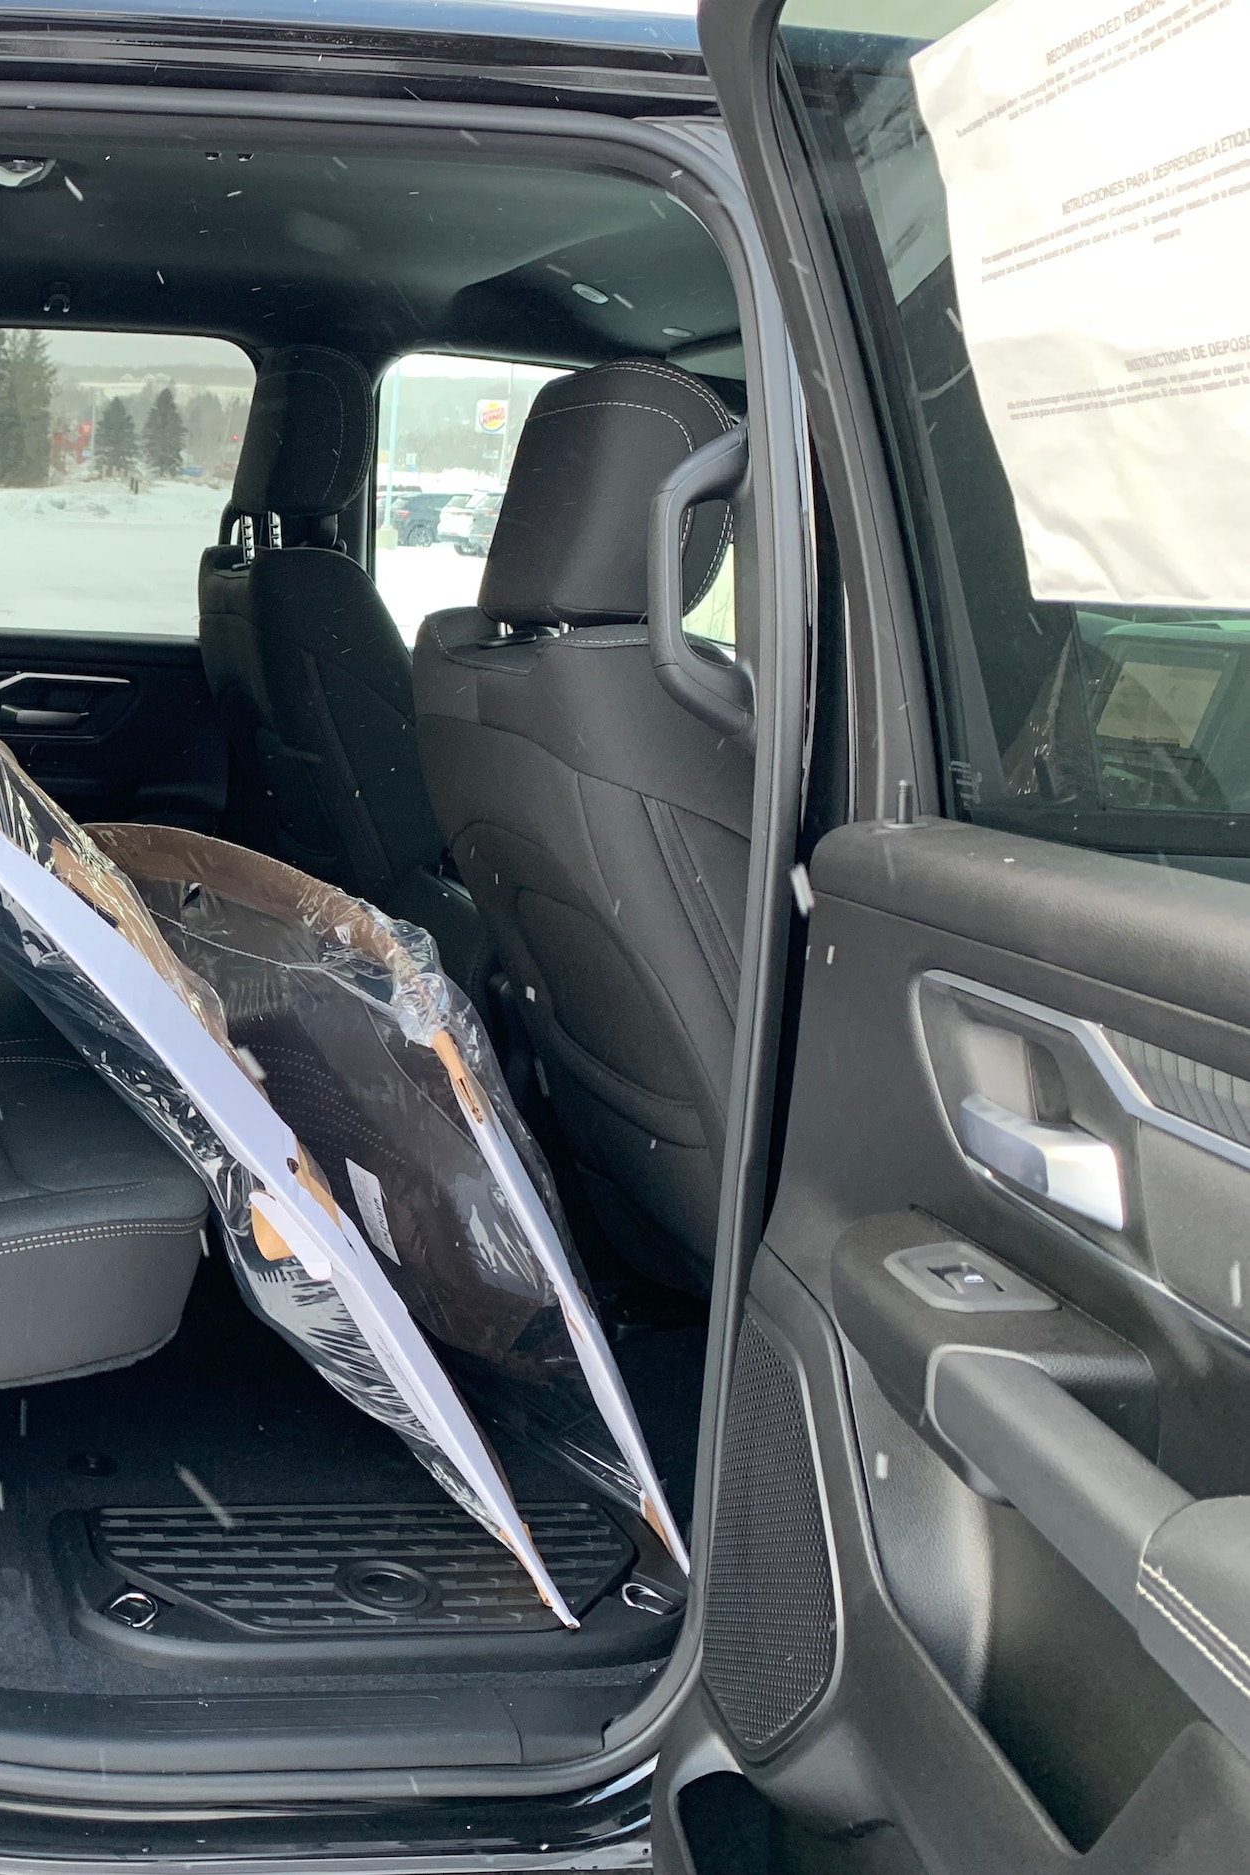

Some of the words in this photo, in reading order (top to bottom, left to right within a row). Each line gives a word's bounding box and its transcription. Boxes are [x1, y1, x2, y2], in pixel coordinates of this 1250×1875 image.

[1046, 16, 1121, 66] RECOMMENDED
[1062, 180, 1126, 216] INSTRUCCIONES
[1126, 171, 1150, 190] PARA
[1152, 146, 1209, 181] DESPRENDER
[1209, 141, 1221, 158] LA
[1125, 348, 1191, 373] INSTRUCTIONS
[1191, 345, 1208, 360] DE
[483, 411, 506, 425] KING
